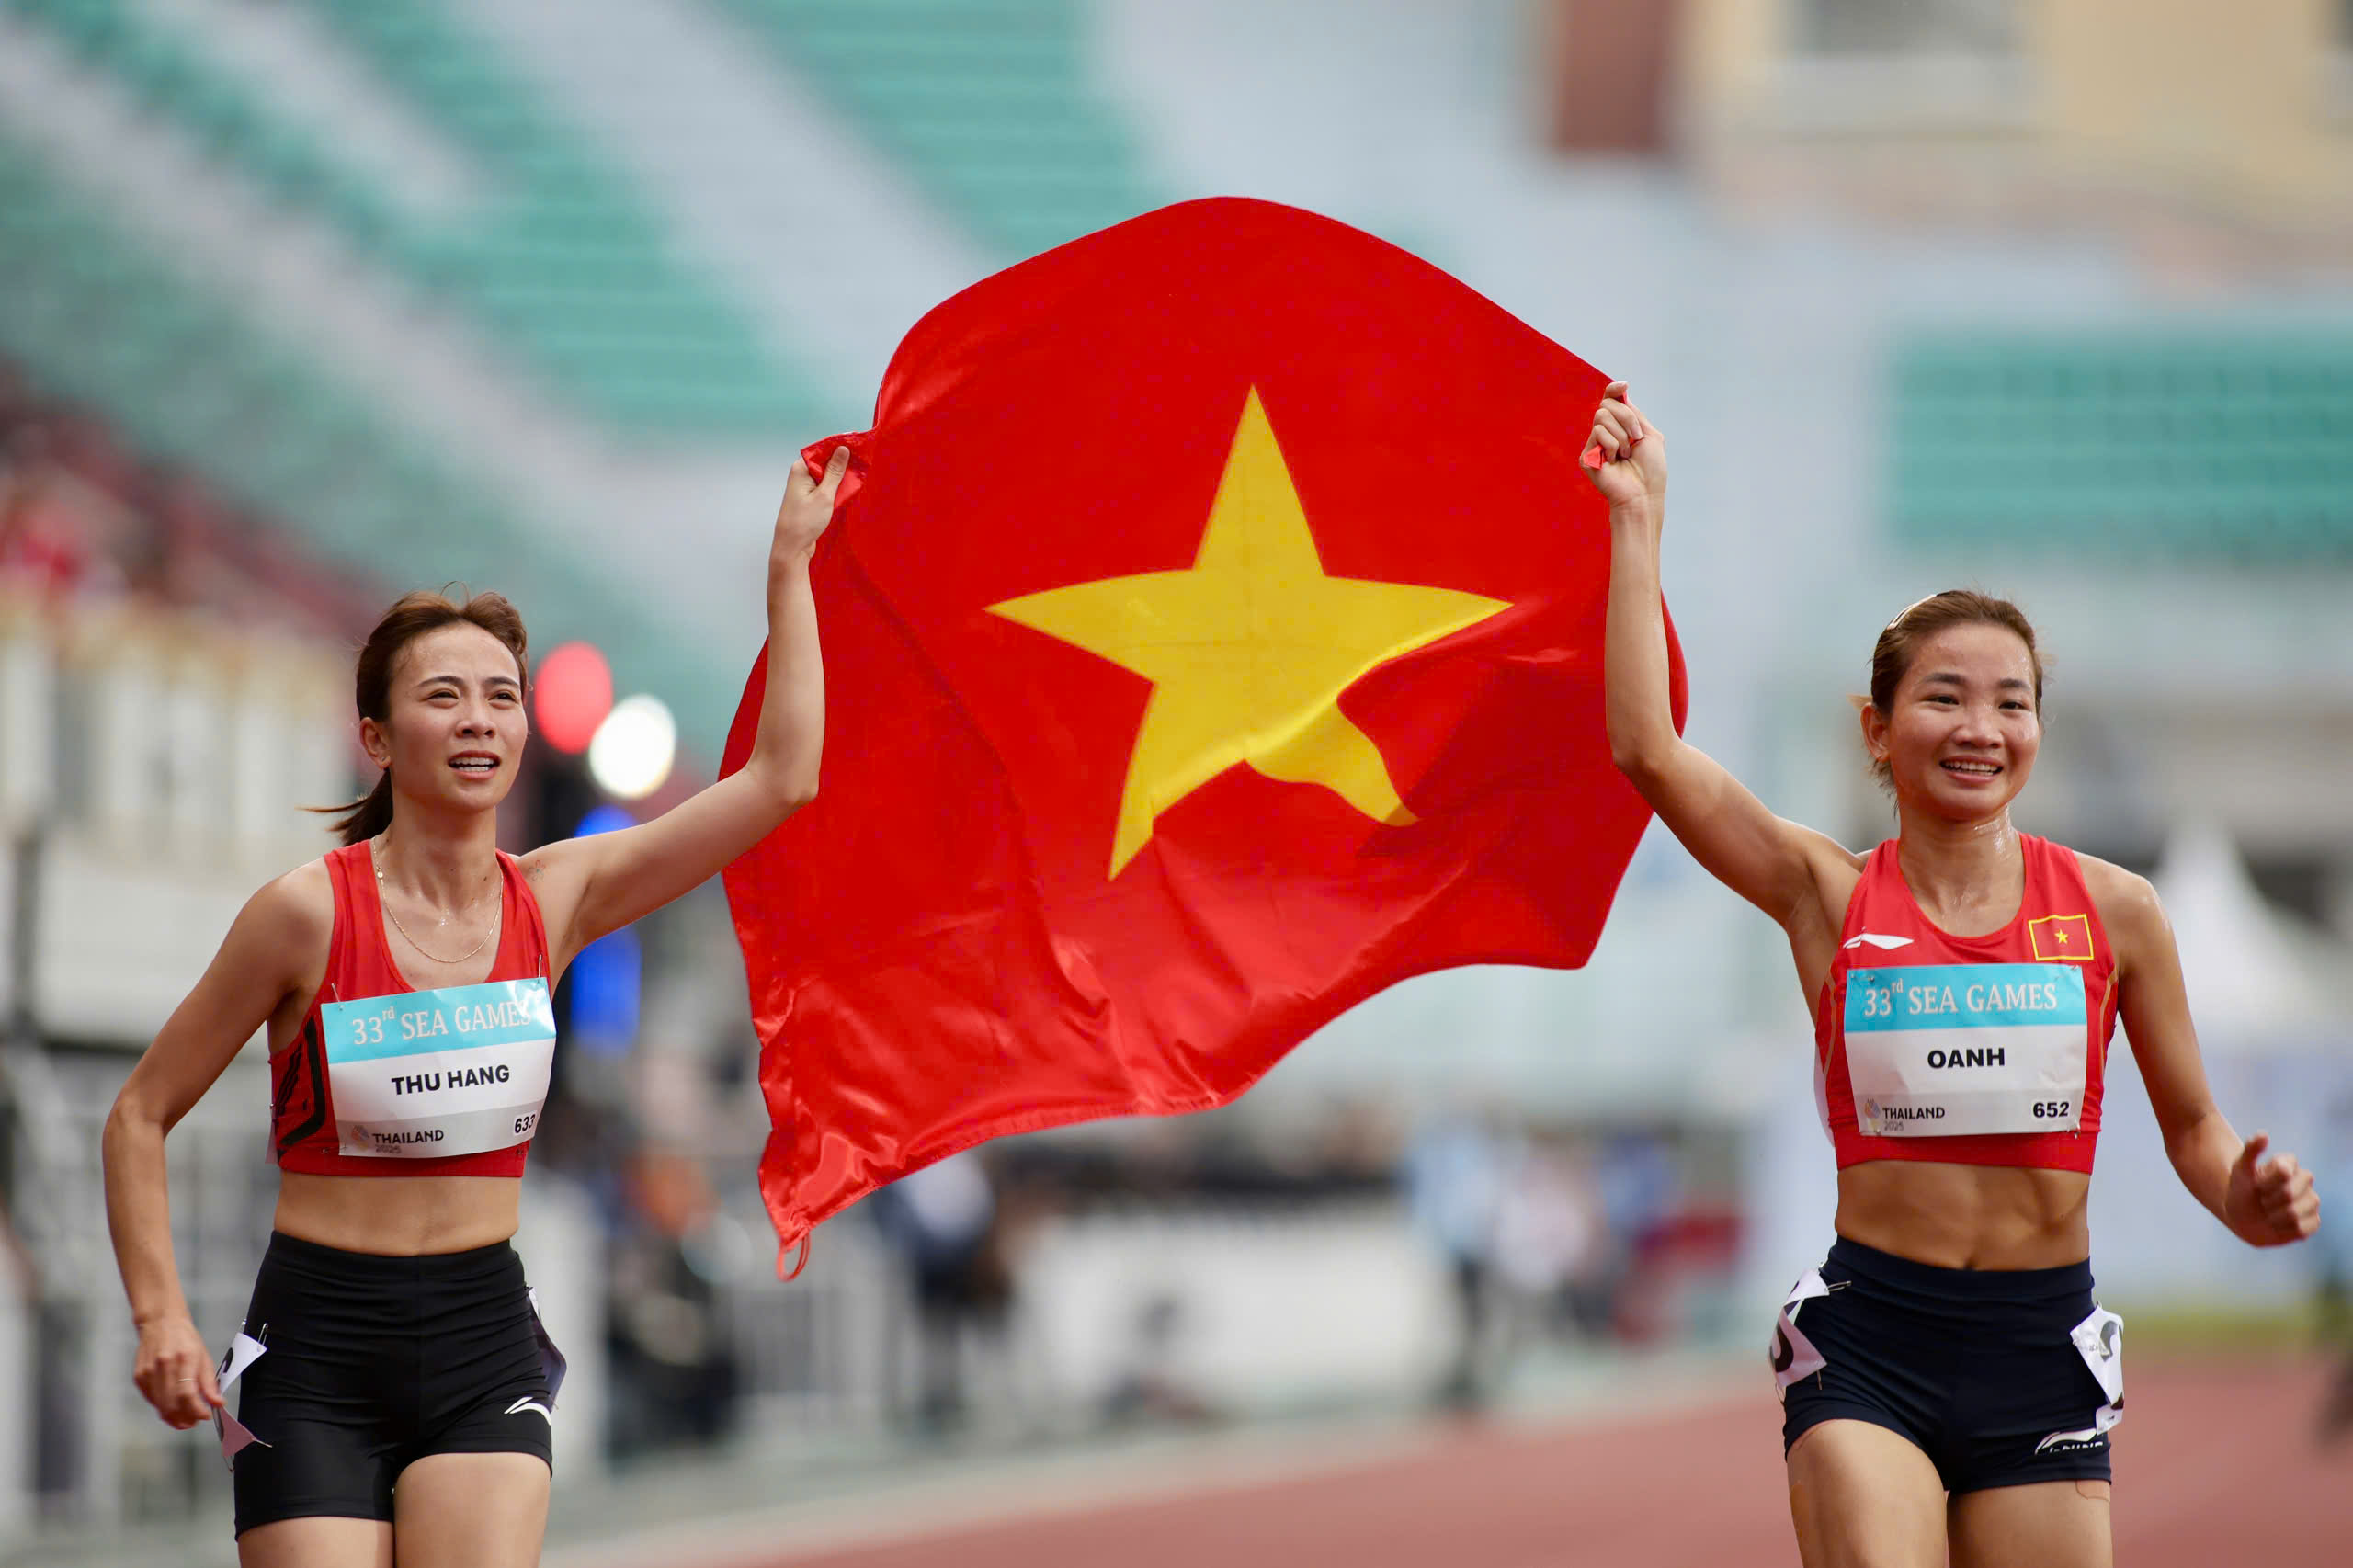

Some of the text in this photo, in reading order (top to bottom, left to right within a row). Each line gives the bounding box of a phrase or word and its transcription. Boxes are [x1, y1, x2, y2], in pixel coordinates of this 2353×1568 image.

[1863, 978, 2058, 1017] 33rd SEA GAMES
[352, 1000, 530, 1045] 33rd SEA GAMES
[1927, 1048, 2006, 1069] OANH
[391, 1064, 510, 1095] THU HANG
[1882, 1107, 1945, 1119] THAILAND
[2033, 1102, 2069, 1118] 652
[515, 1114, 536, 1133] 633
[372, 1130, 444, 1144] THAILAND
